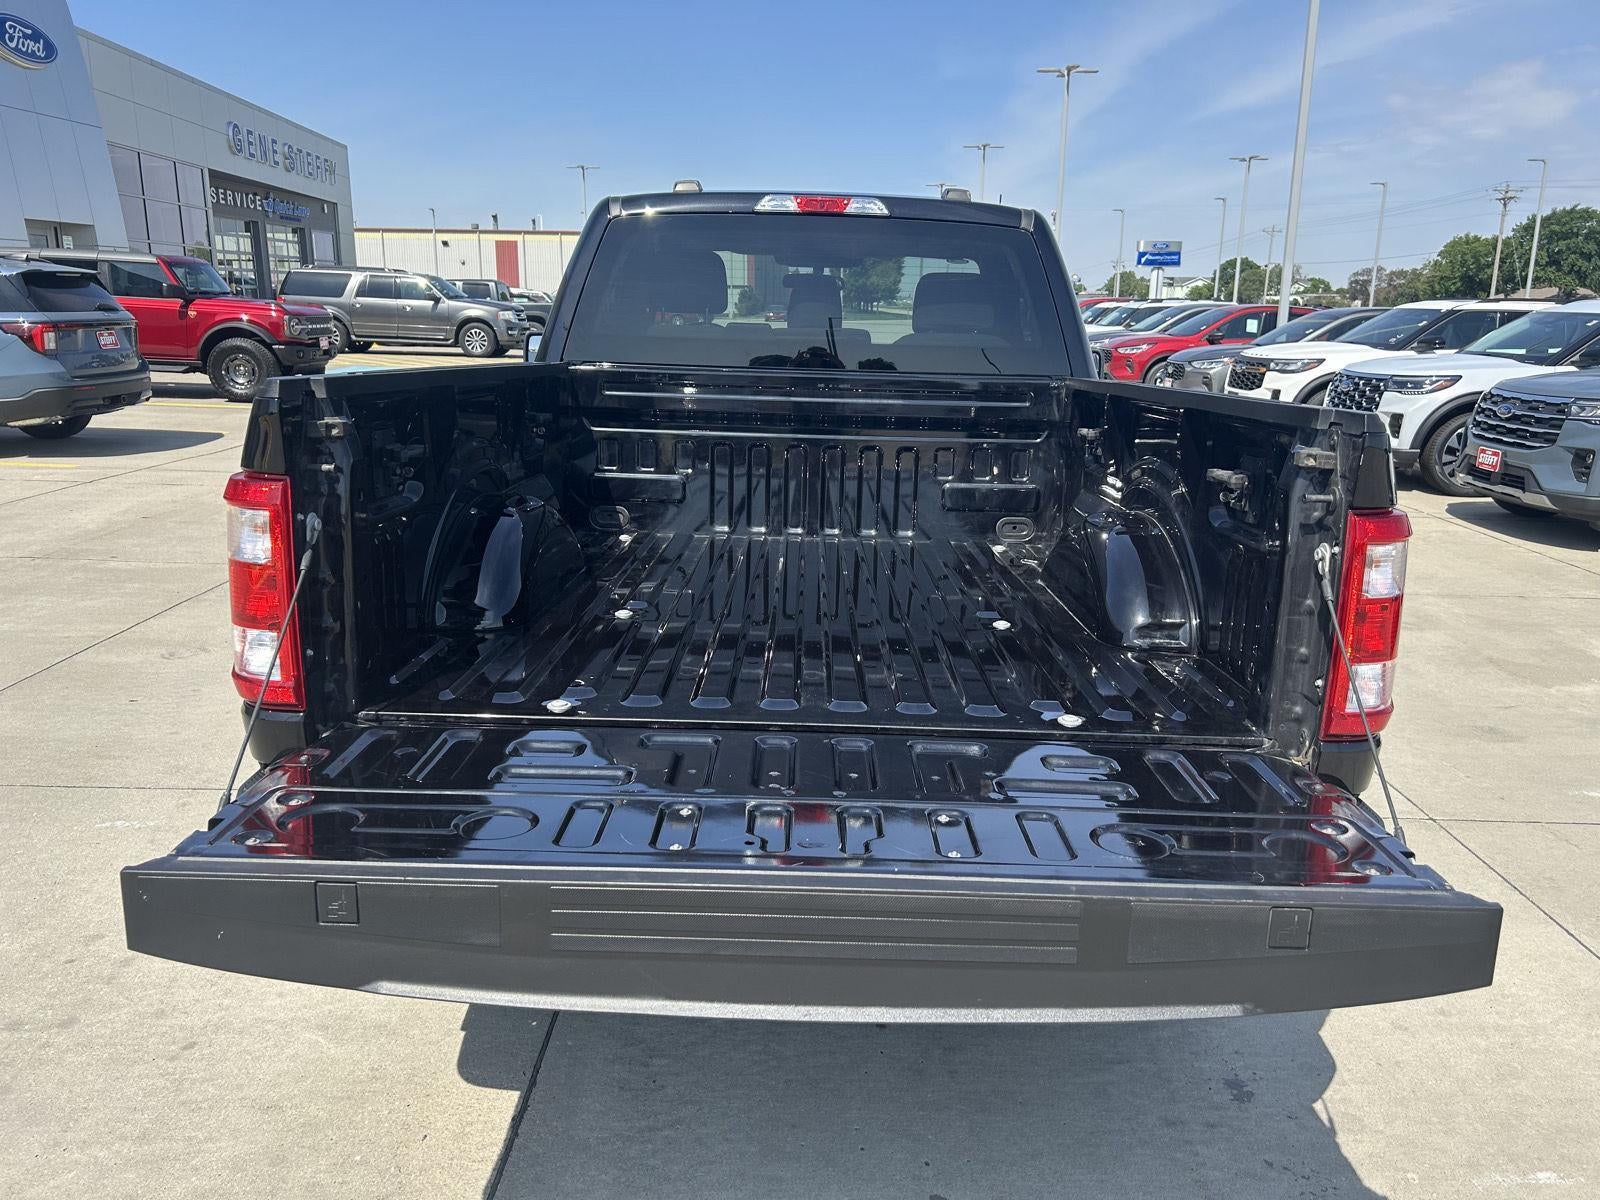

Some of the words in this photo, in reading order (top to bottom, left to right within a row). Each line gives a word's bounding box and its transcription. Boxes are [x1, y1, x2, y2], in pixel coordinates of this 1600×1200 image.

[5, 21, 46, 57] Ford
[227, 121, 280, 168] GENE
[283, 142, 337, 185] STEFFY
[210, 186, 262, 210] SERVICE
[1479, 453, 1498, 465] STEFFY
